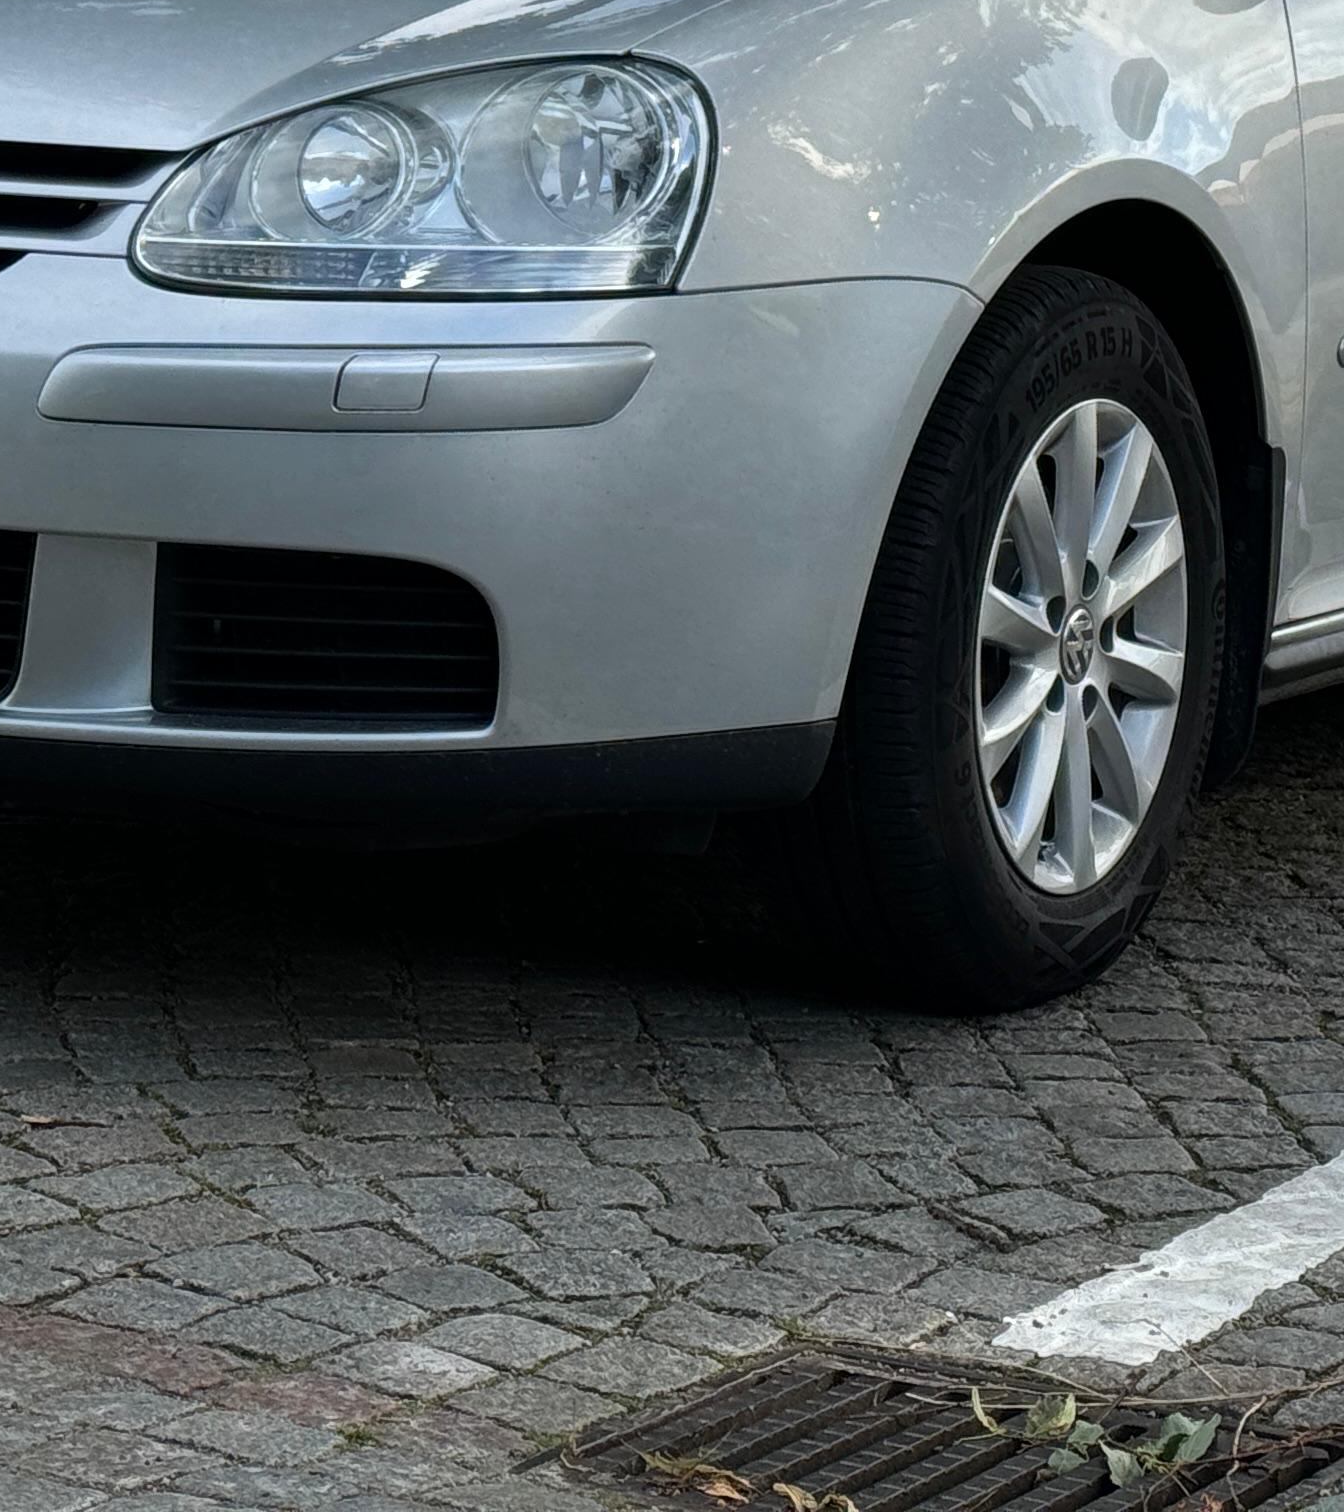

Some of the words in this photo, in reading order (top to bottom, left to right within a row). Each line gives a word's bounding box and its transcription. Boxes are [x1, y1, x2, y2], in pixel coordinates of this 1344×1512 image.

[1024, 337, 1082, 413] 195/65
[1085, 330, 1098, 361] R
[1100, 326, 1116, 357] 15
[1120, 327, 1133, 358] H
